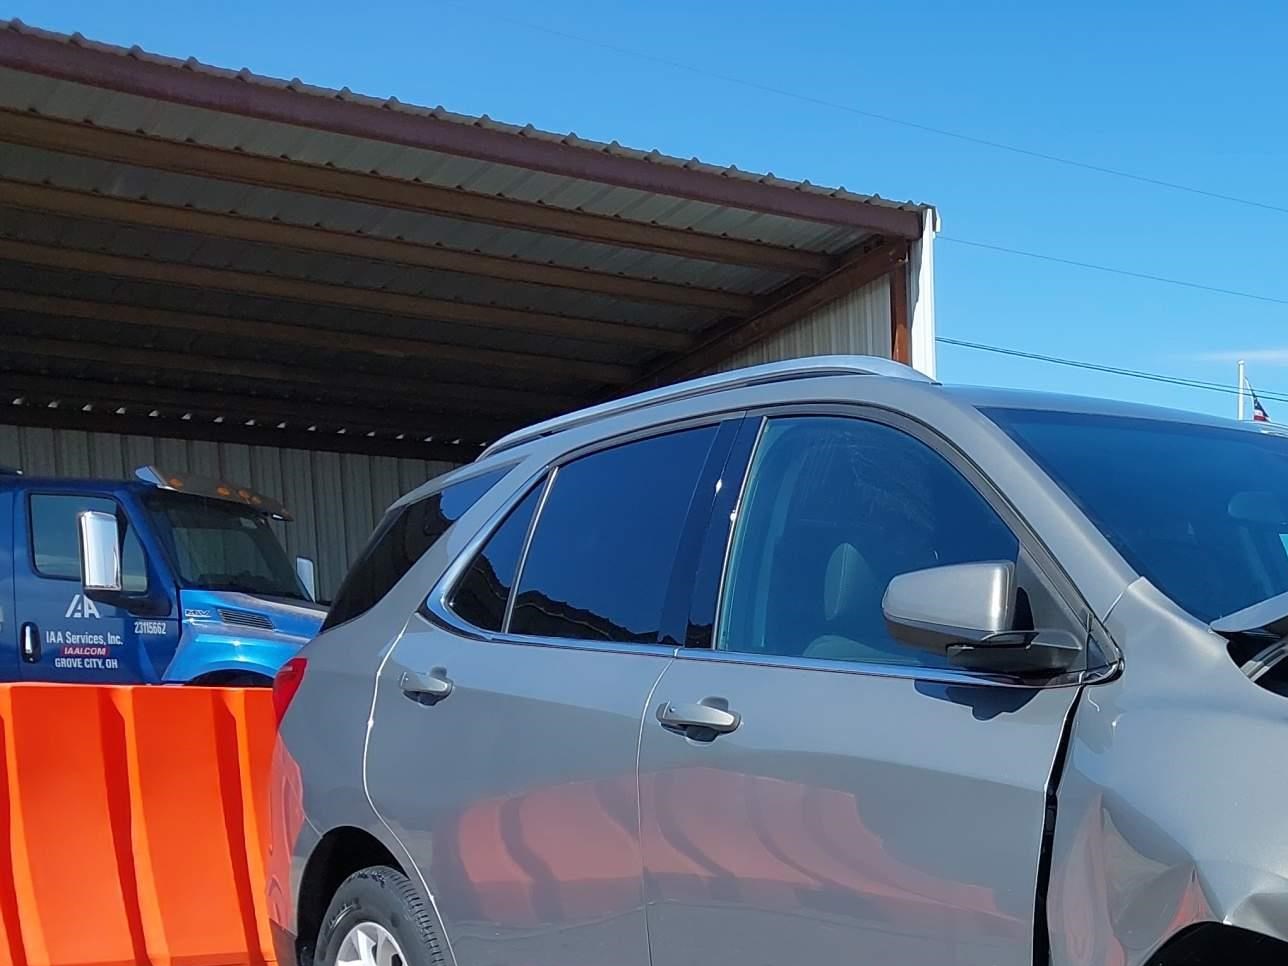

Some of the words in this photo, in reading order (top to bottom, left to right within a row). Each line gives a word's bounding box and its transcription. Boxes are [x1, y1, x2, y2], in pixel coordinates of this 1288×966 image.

[46, 631, 64, 644] IAA
[65, 631, 107, 645] Services,
[107, 632, 123, 645] Inc.
[55, 657, 83, 668] GROVE
[105, 659, 118, 669] OH
